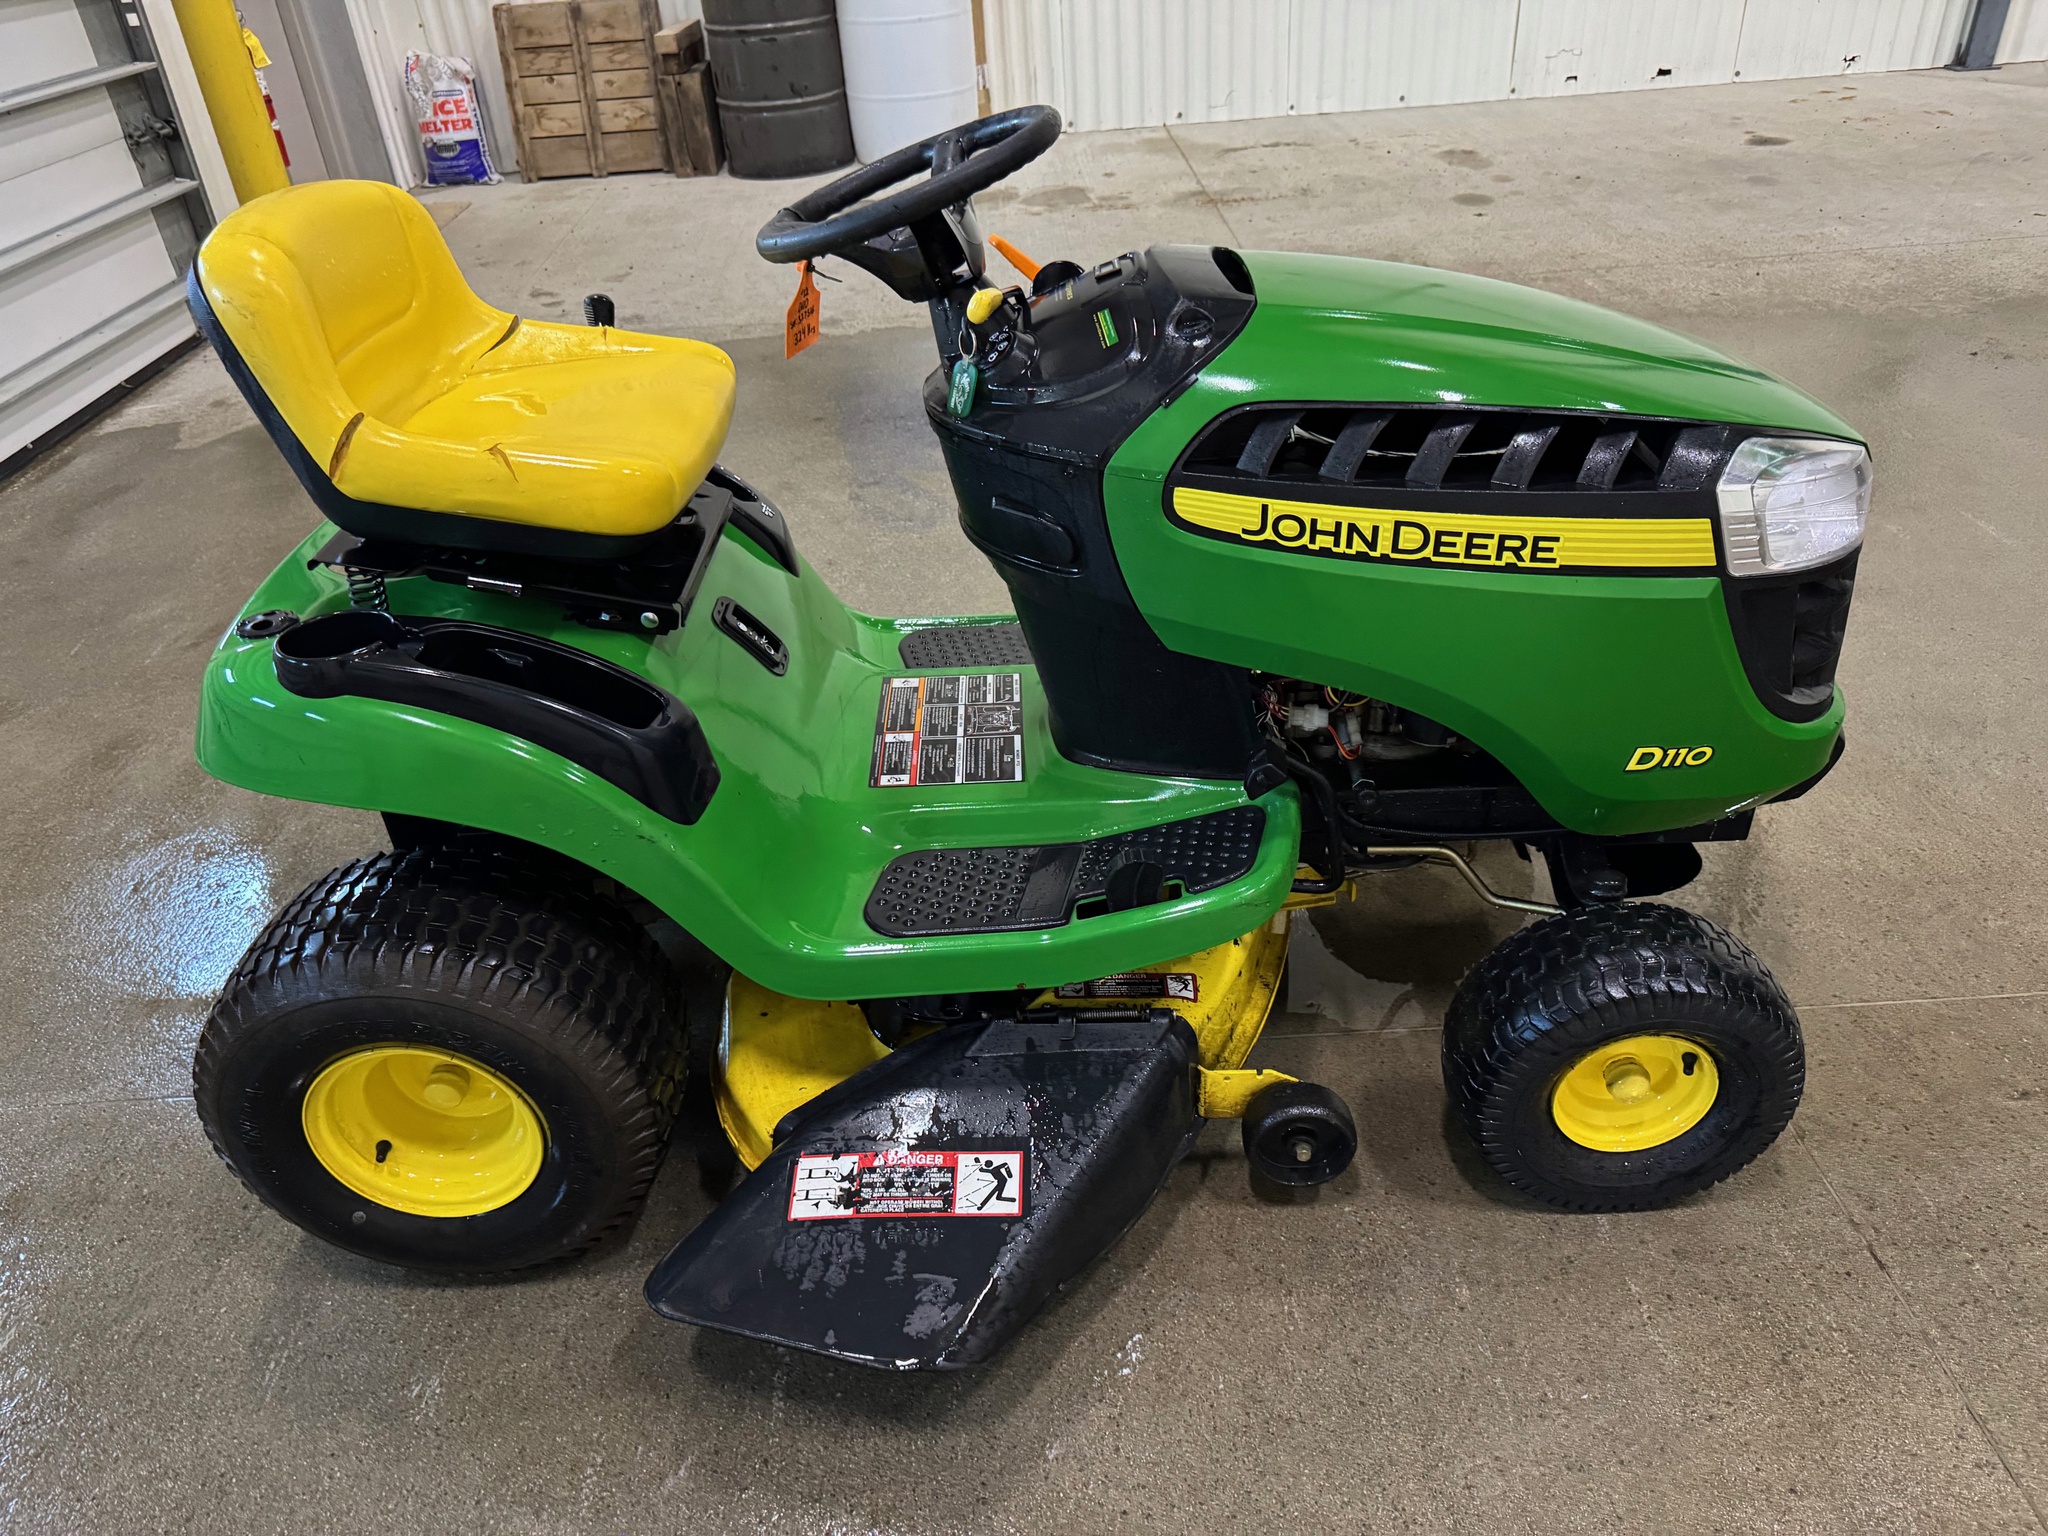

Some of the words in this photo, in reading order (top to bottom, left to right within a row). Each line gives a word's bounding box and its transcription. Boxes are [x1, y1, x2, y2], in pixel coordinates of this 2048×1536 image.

[433, 97, 468, 117] ICE
[419, 118, 473, 134] MELTER
[1241, 503, 1381, 555] JOHN
[1392, 520, 1561, 565] DEERE
[1624, 746, 1714, 772] D110
[888, 1153, 944, 1165] DANGER
